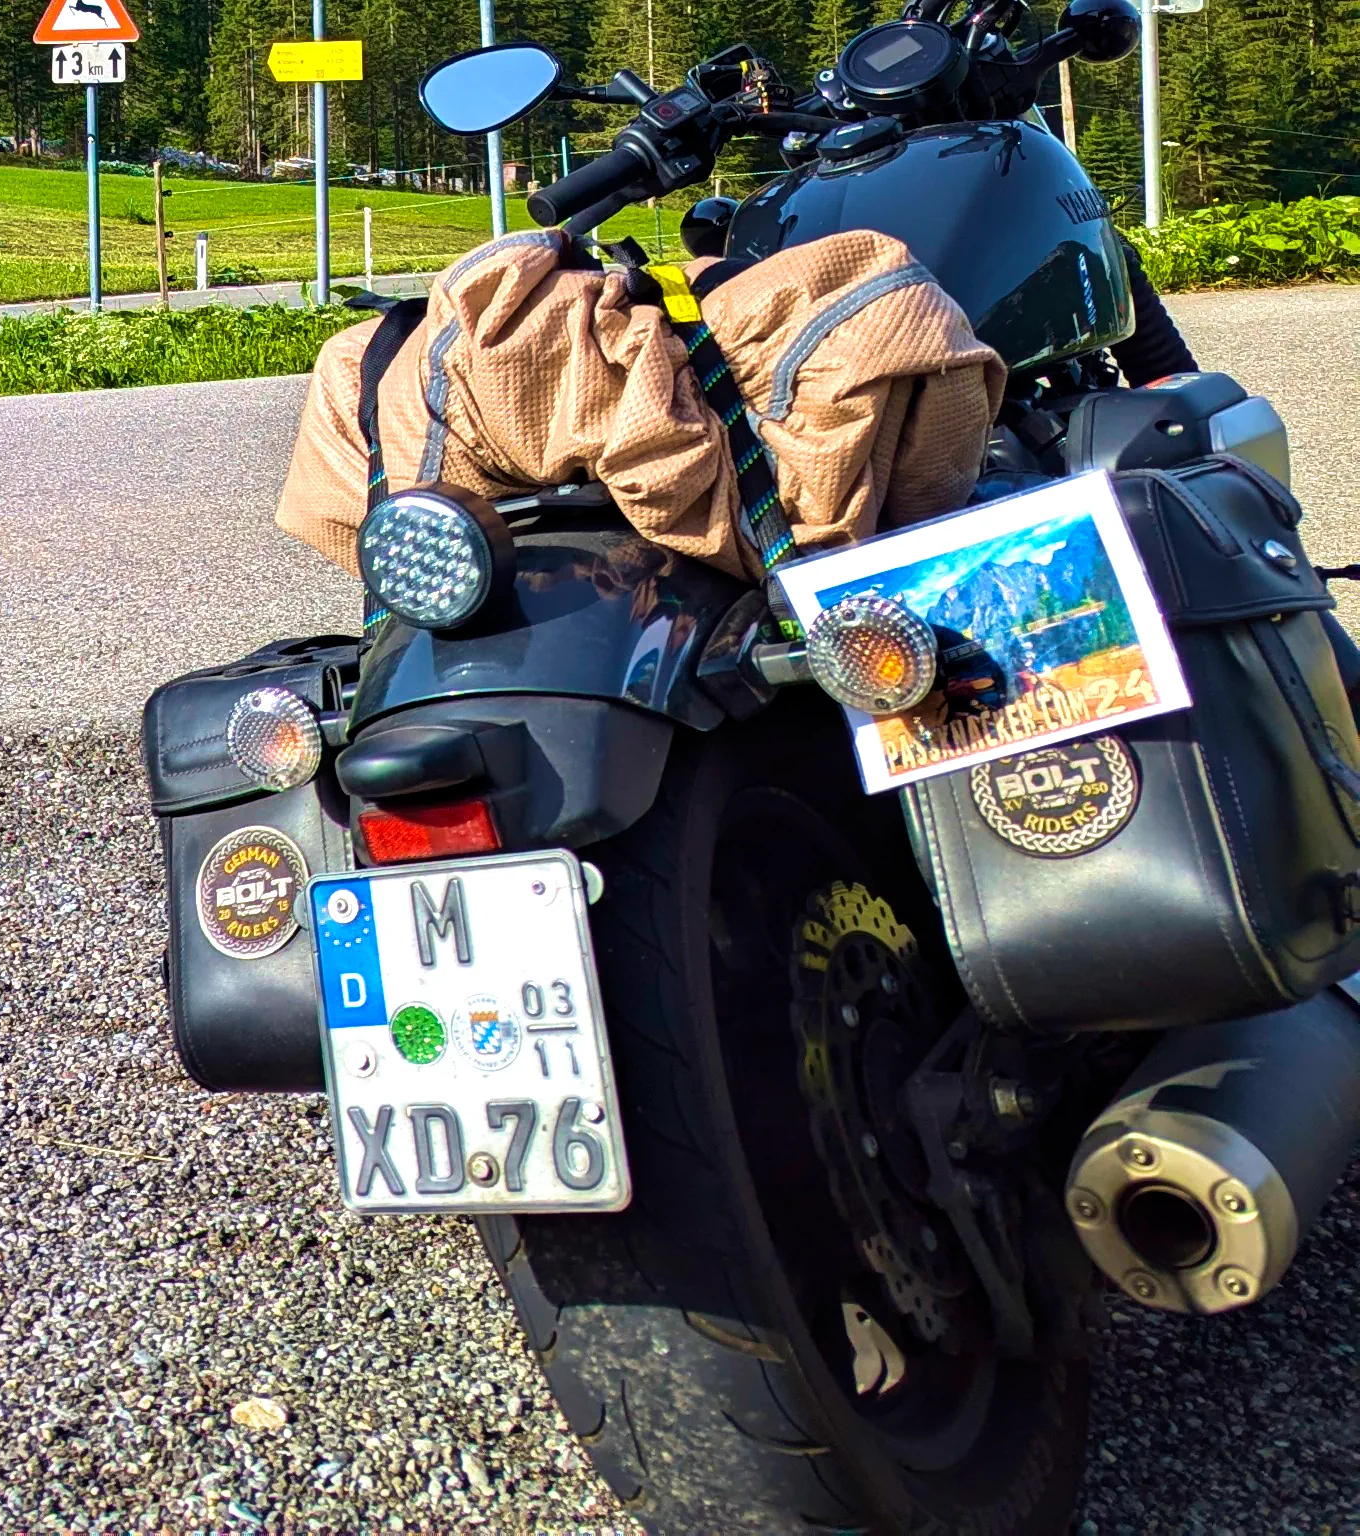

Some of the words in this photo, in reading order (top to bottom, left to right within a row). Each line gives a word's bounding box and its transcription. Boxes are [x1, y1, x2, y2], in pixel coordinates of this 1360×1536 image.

[71, 51, 83, 76] 3
[88, 61, 104, 76] km
[886, 690, 1088, 773] PASSKNACKER.COM
[1088, 668, 1157, 718] 24
[996, 757, 1101, 799] BOLT
[1002, 797, 1025, 812] XV
[1082, 782, 1109, 796] 950
[1024, 801, 1098, 833] RIDERS
[224, 846, 281, 874] GERMAN
[216, 877, 293, 907] BOLT
[227, 916, 280, 938] RIDERS
[410, 874, 474, 967] M
[340, 972, 368, 1008] D
[521, 978, 574, 1018] 03
[534, 1038, 581, 1077] 11
[347, 1100, 469, 1196] XD
[486, 1096, 607, 1192] 76
